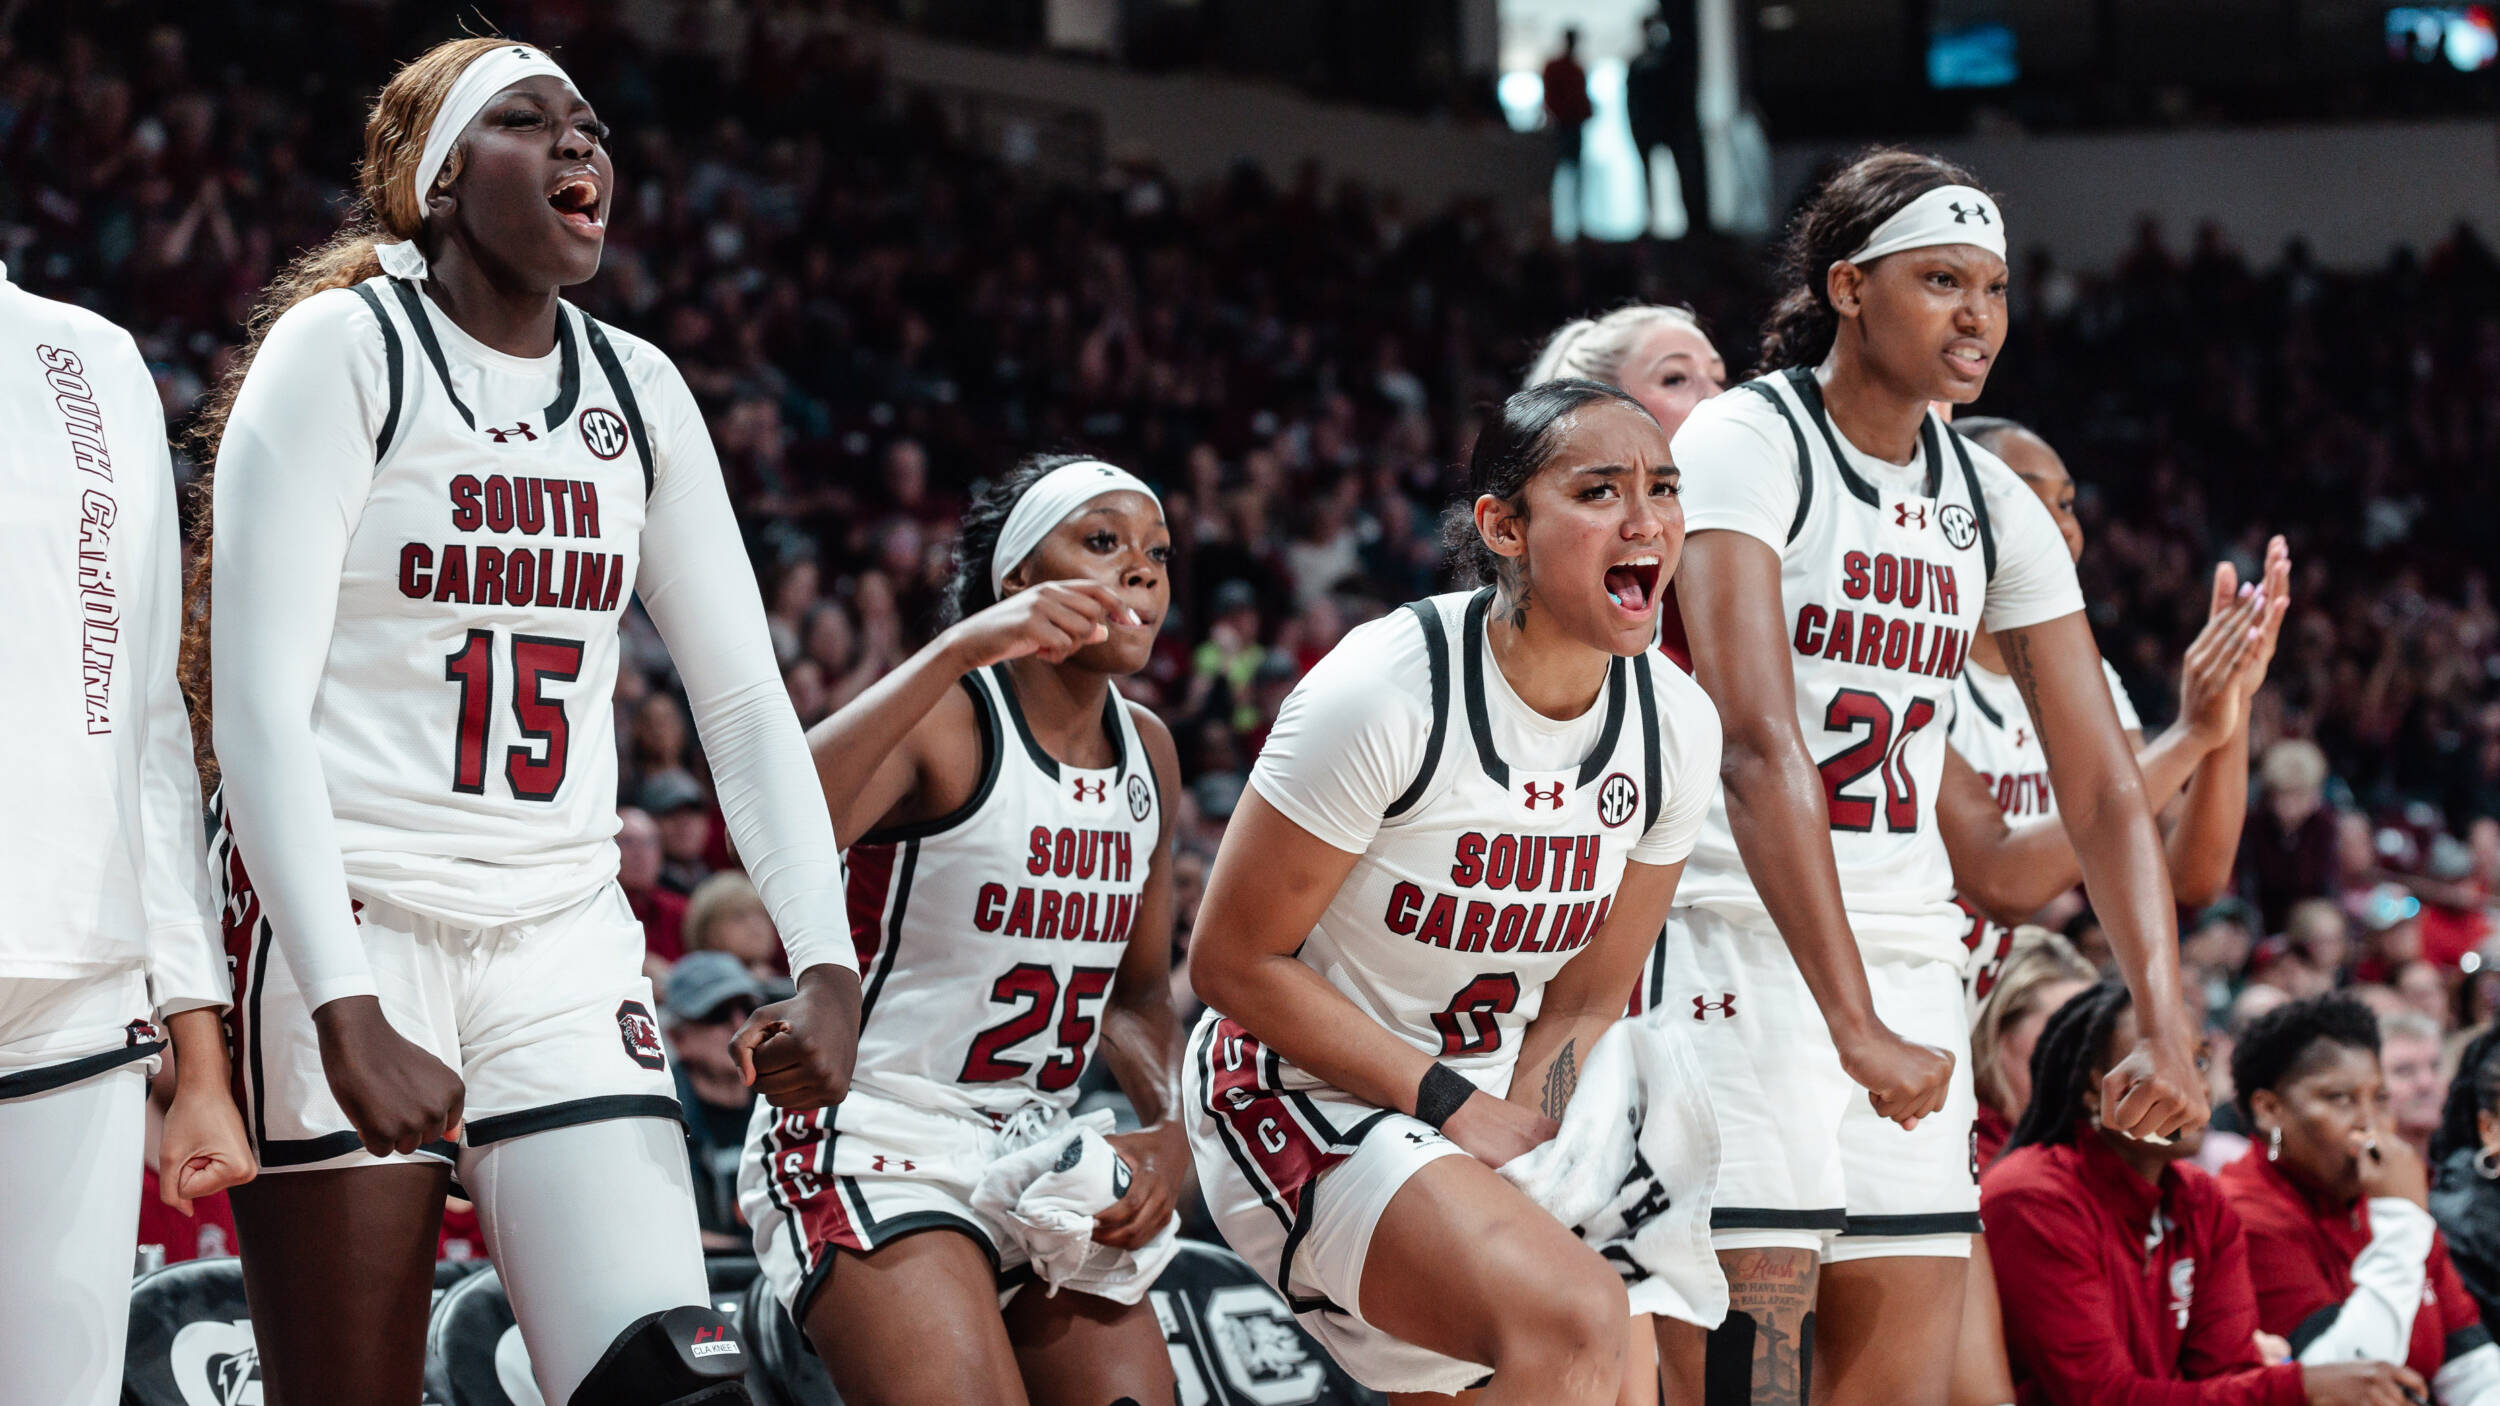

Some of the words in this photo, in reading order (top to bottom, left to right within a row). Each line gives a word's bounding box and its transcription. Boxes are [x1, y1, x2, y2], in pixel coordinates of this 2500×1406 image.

[583, 410, 625, 456] SEC
[449, 474, 601, 538] SOUTH
[1941, 507, 1976, 548] SEC
[37, 344, 113, 483] SOUTH
[78, 488, 120, 736] CAROLINA
[399, 542, 623, 611] CAROLINA
[1843, 550, 1959, 616] SOUTH
[445, 629, 585, 803] 15
[1601, 777, 1635, 824] SEC
[1027, 825, 1131, 882] SOUTH
[1451, 831, 1601, 893] SOUTH
[956, 962, 1116, 1093] 25
